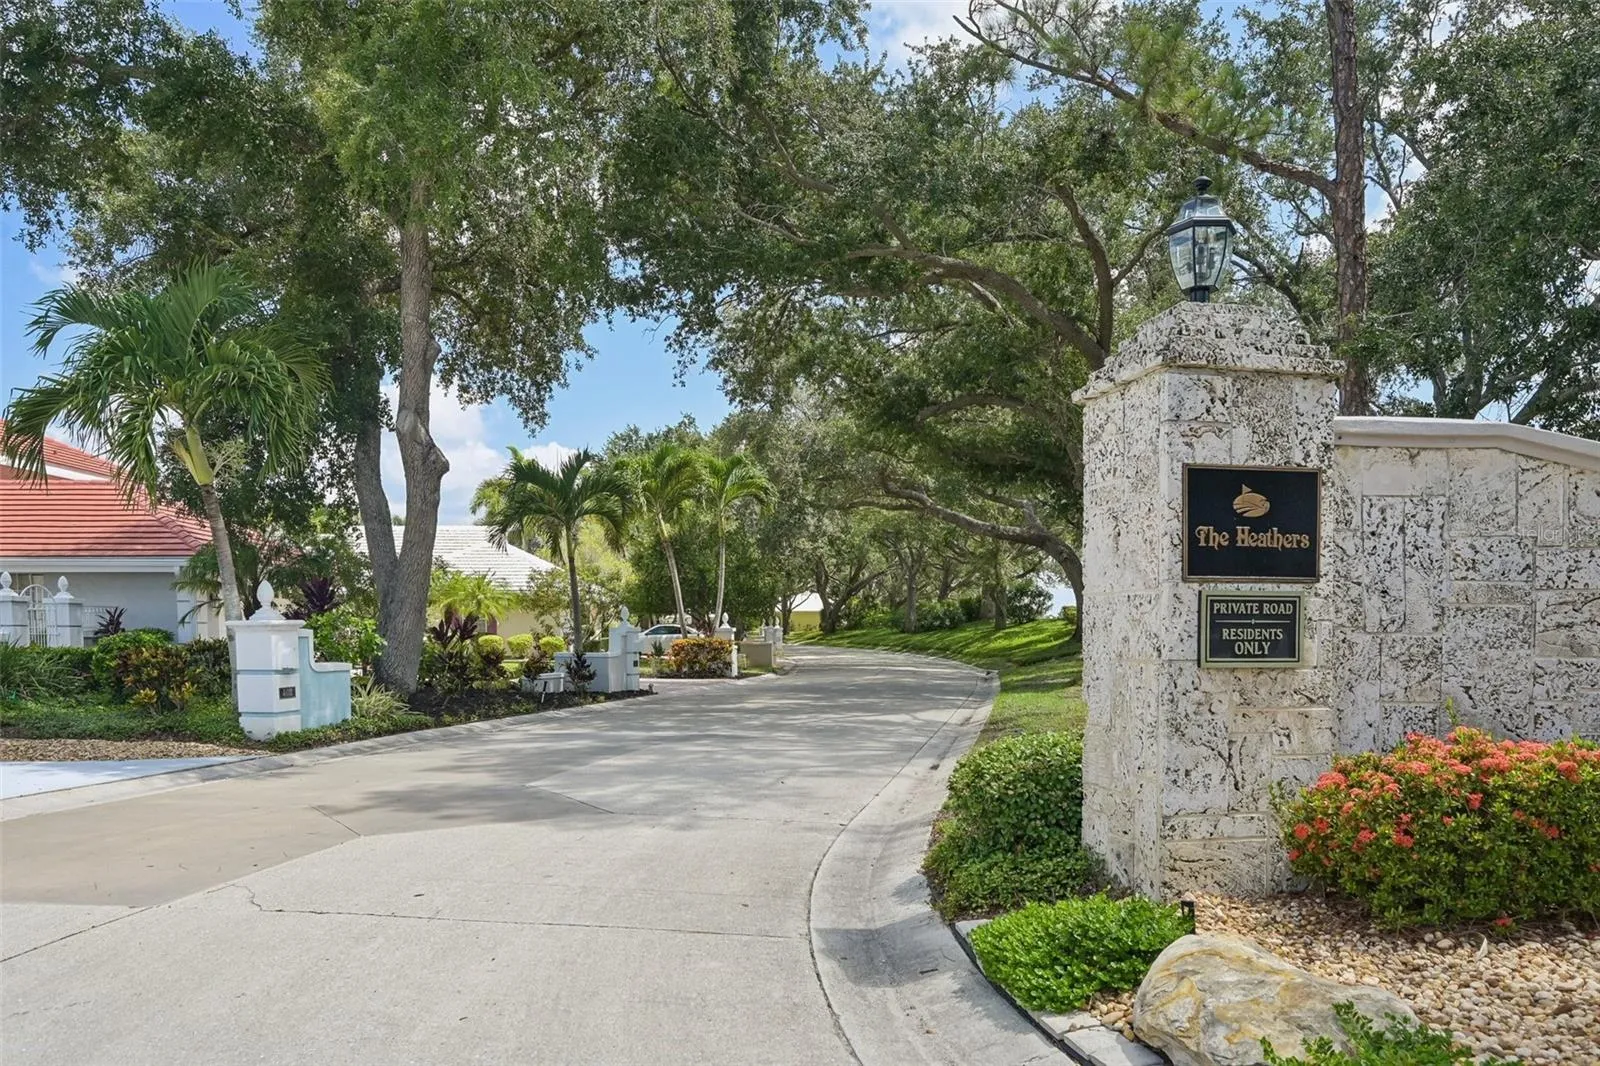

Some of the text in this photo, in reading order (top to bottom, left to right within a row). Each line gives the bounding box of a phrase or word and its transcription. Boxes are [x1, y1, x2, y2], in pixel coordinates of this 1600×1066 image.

[1195, 526, 1310, 551] The Heathers
[1213, 602, 1294, 615] PRIVATE ROAD
[1222, 628, 1284, 641] RESIDENTS
[1234, 641, 1271, 656] ONLY
